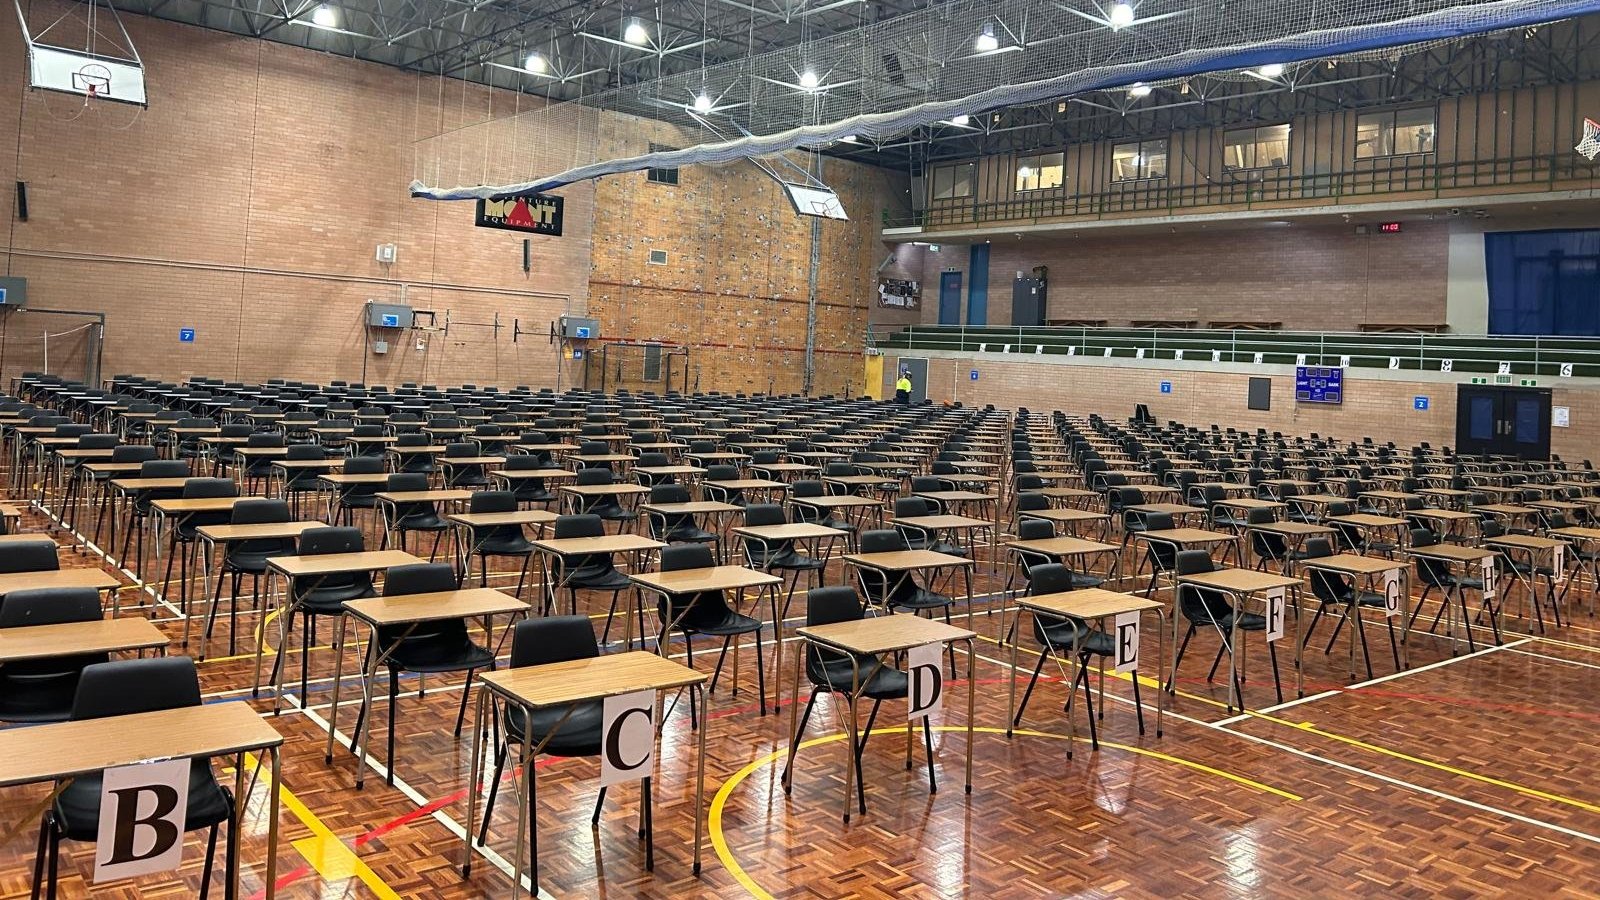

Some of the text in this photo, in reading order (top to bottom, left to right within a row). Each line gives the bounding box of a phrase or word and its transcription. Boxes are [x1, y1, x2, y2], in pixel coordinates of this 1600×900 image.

[483, 215, 555, 230] EQUIPMENT
[1442, 360, 1451, 371] 8
[1500, 362, 1508, 373] 7
[1561, 364, 1570, 376] 6
[1482, 566, 1495, 593] H
[1554, 553, 1563, 580] J
[1385, 579, 1399, 611] G
[1267, 596, 1283, 635] F
[1116, 622, 1138, 667] E
[909, 663, 942, 714] D
[605, 704, 653, 771] C
[101, 784, 179, 867] B
